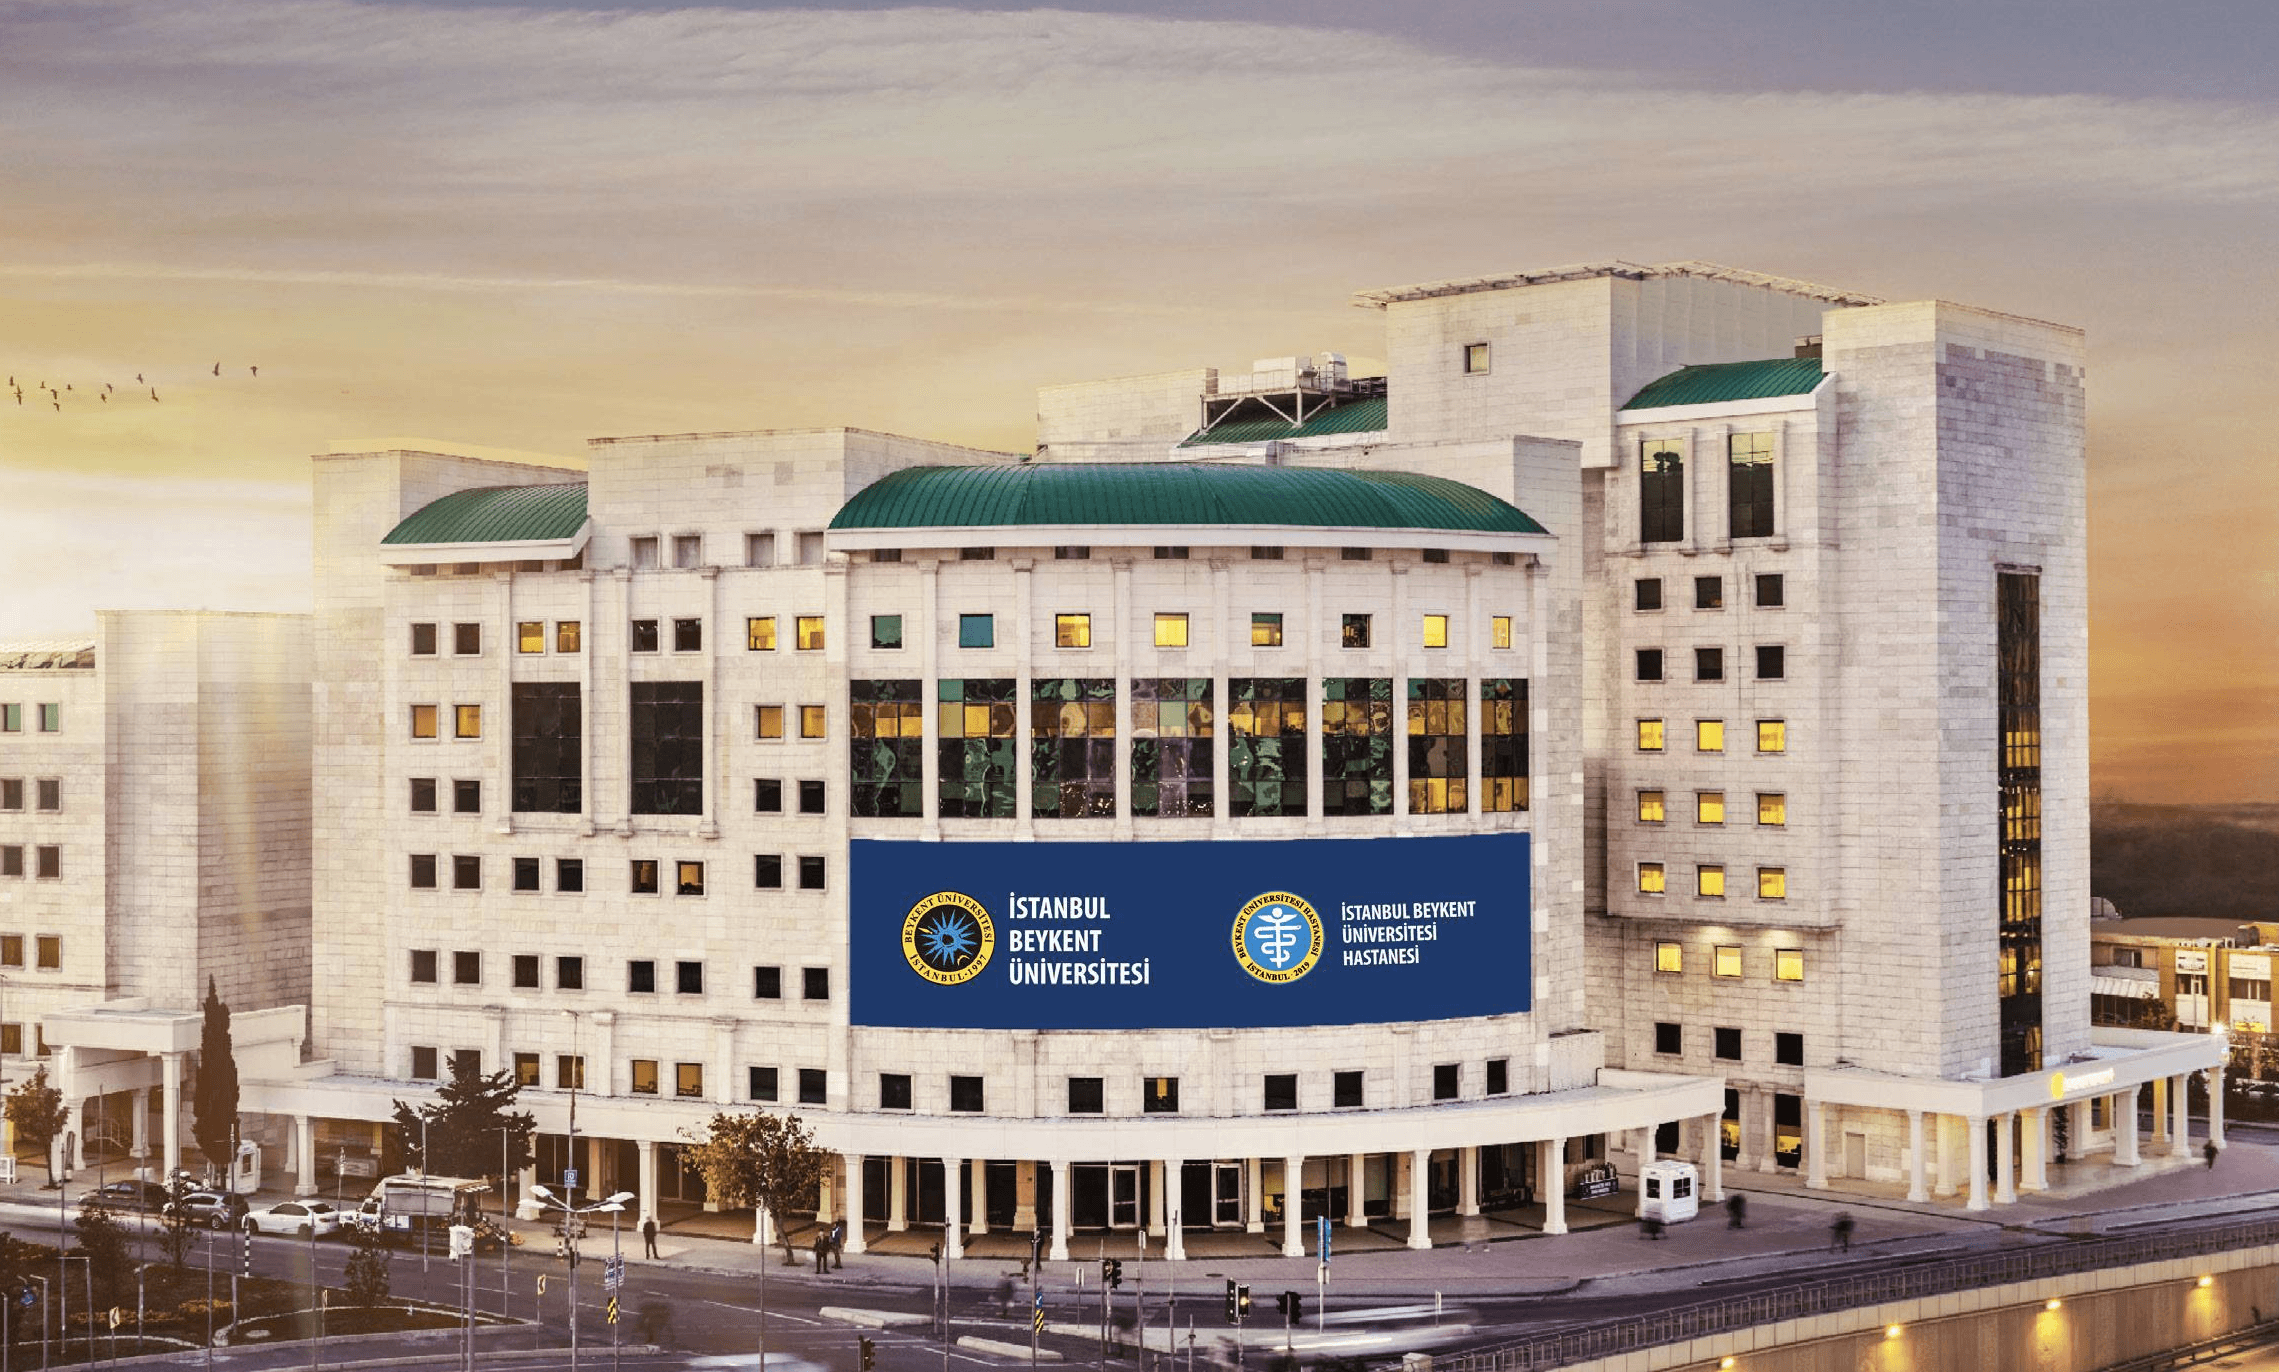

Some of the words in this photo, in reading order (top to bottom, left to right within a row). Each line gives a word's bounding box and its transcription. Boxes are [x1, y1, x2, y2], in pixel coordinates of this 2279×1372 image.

[1010, 891, 1110, 918] İSTANBUL
[1342, 902, 1411, 921] İSTANBUL
[1413, 900, 1477, 919] BEYKENT
[904, 898, 934, 943] BEYKENT
[936, 894, 994, 943] ÜNİVERSİTESİ
[1234, 915, 1247, 959] BEYKENT
[1243, 894, 1305, 916] ÜNİVERSİTESİ
[1303, 907, 1322, 957] HASTANESİ
[1010, 930, 1102, 952] BEYKENT
[1342, 922, 1437, 944] ÜNİVERSİTESİ
[1343, 945, 1420, 966] HASTANESİ
[1010, 957, 1150, 985] ÜNİVERSİTESİ
